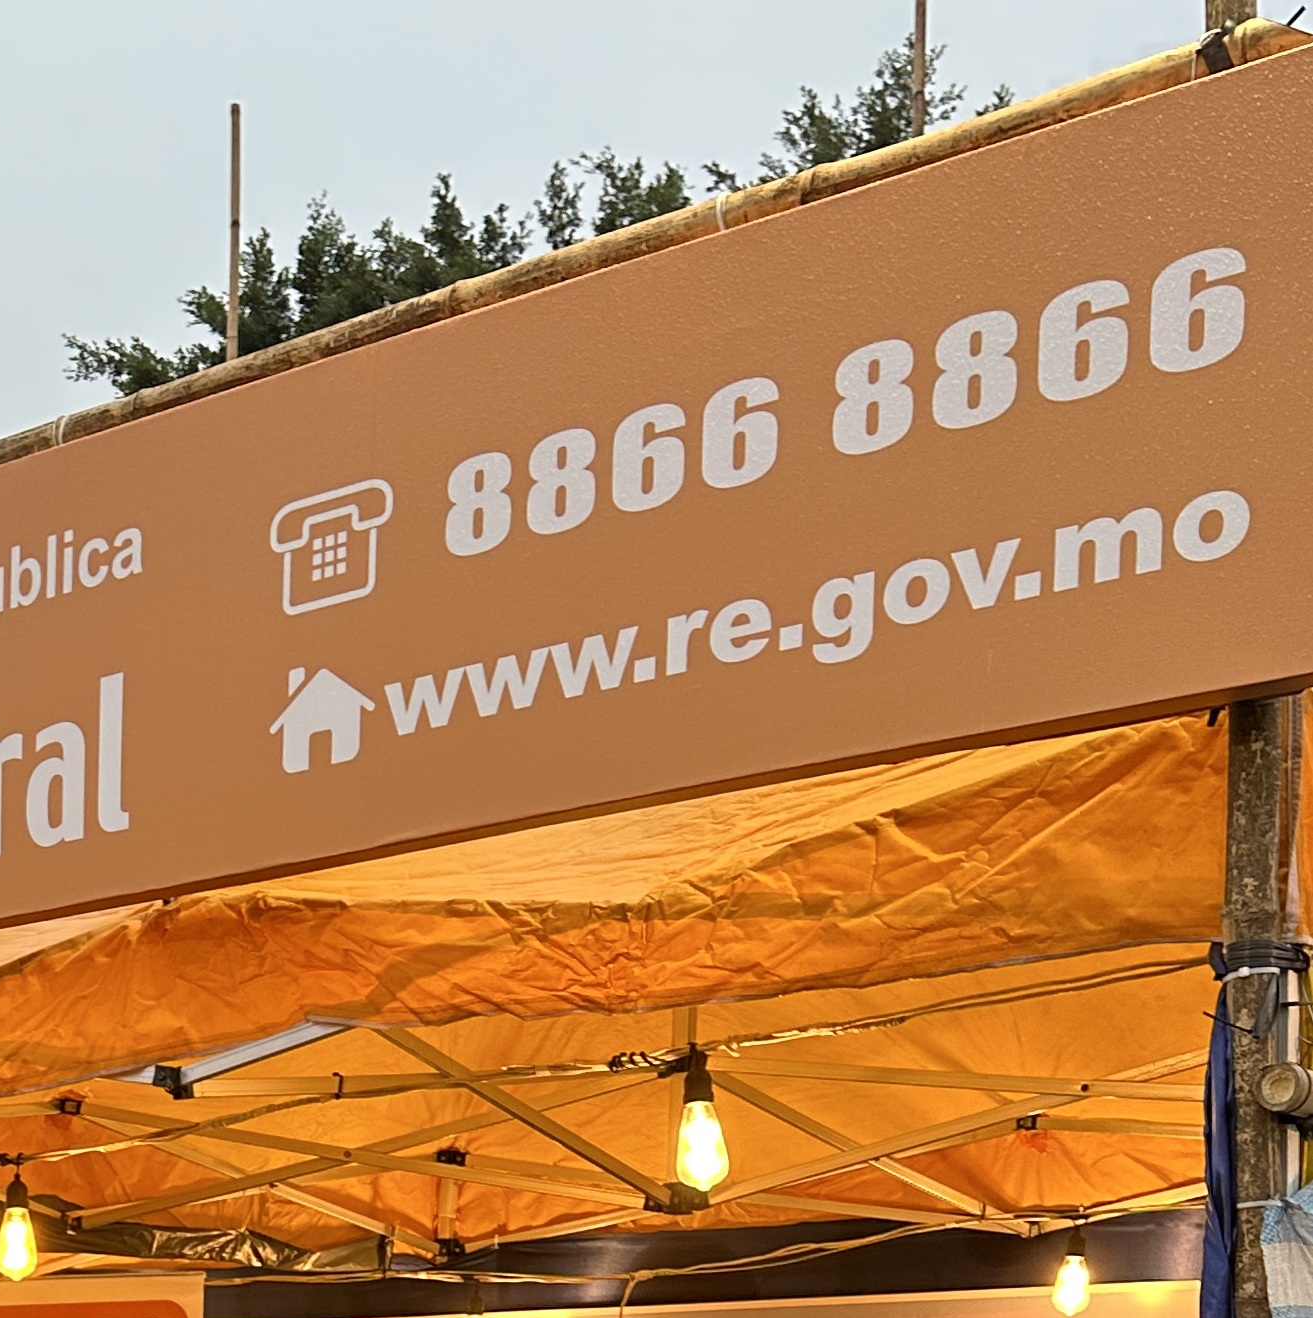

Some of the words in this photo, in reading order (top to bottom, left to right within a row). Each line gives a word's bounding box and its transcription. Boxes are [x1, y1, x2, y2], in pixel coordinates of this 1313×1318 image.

[444, 377, 780, 557] 8866
[832, 246, 1247, 455] 8866
[383, 490, 1252, 736] www.re.gov.mo
